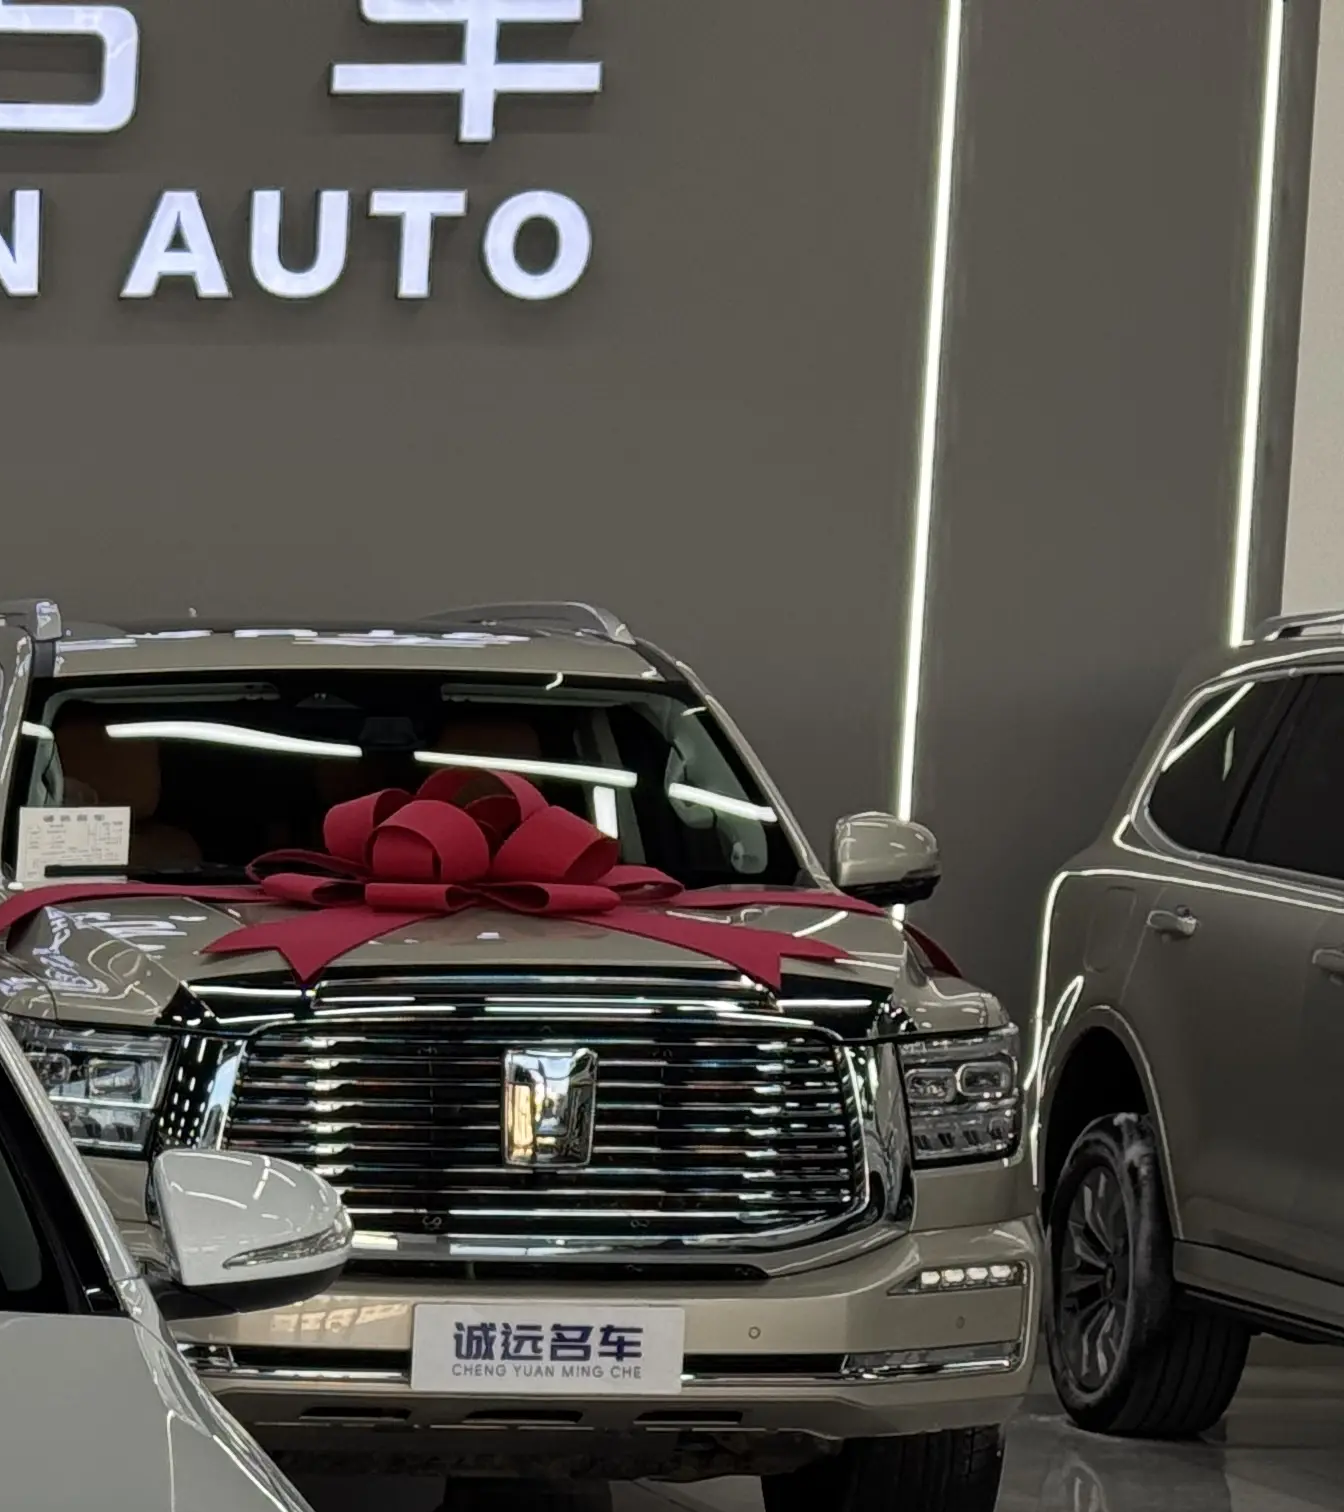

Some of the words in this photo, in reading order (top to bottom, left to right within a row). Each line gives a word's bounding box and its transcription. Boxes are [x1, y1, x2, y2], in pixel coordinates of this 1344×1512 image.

[119, 189, 593, 301] AUTO
[453, 1322, 644, 1362] 诚远名车
[451, 1363, 507, 1377] CHENG
[513, 1364, 555, 1378] YUAN
[561, 1364, 604, 1379] MING
[610, 1365, 642, 1379] CHE
